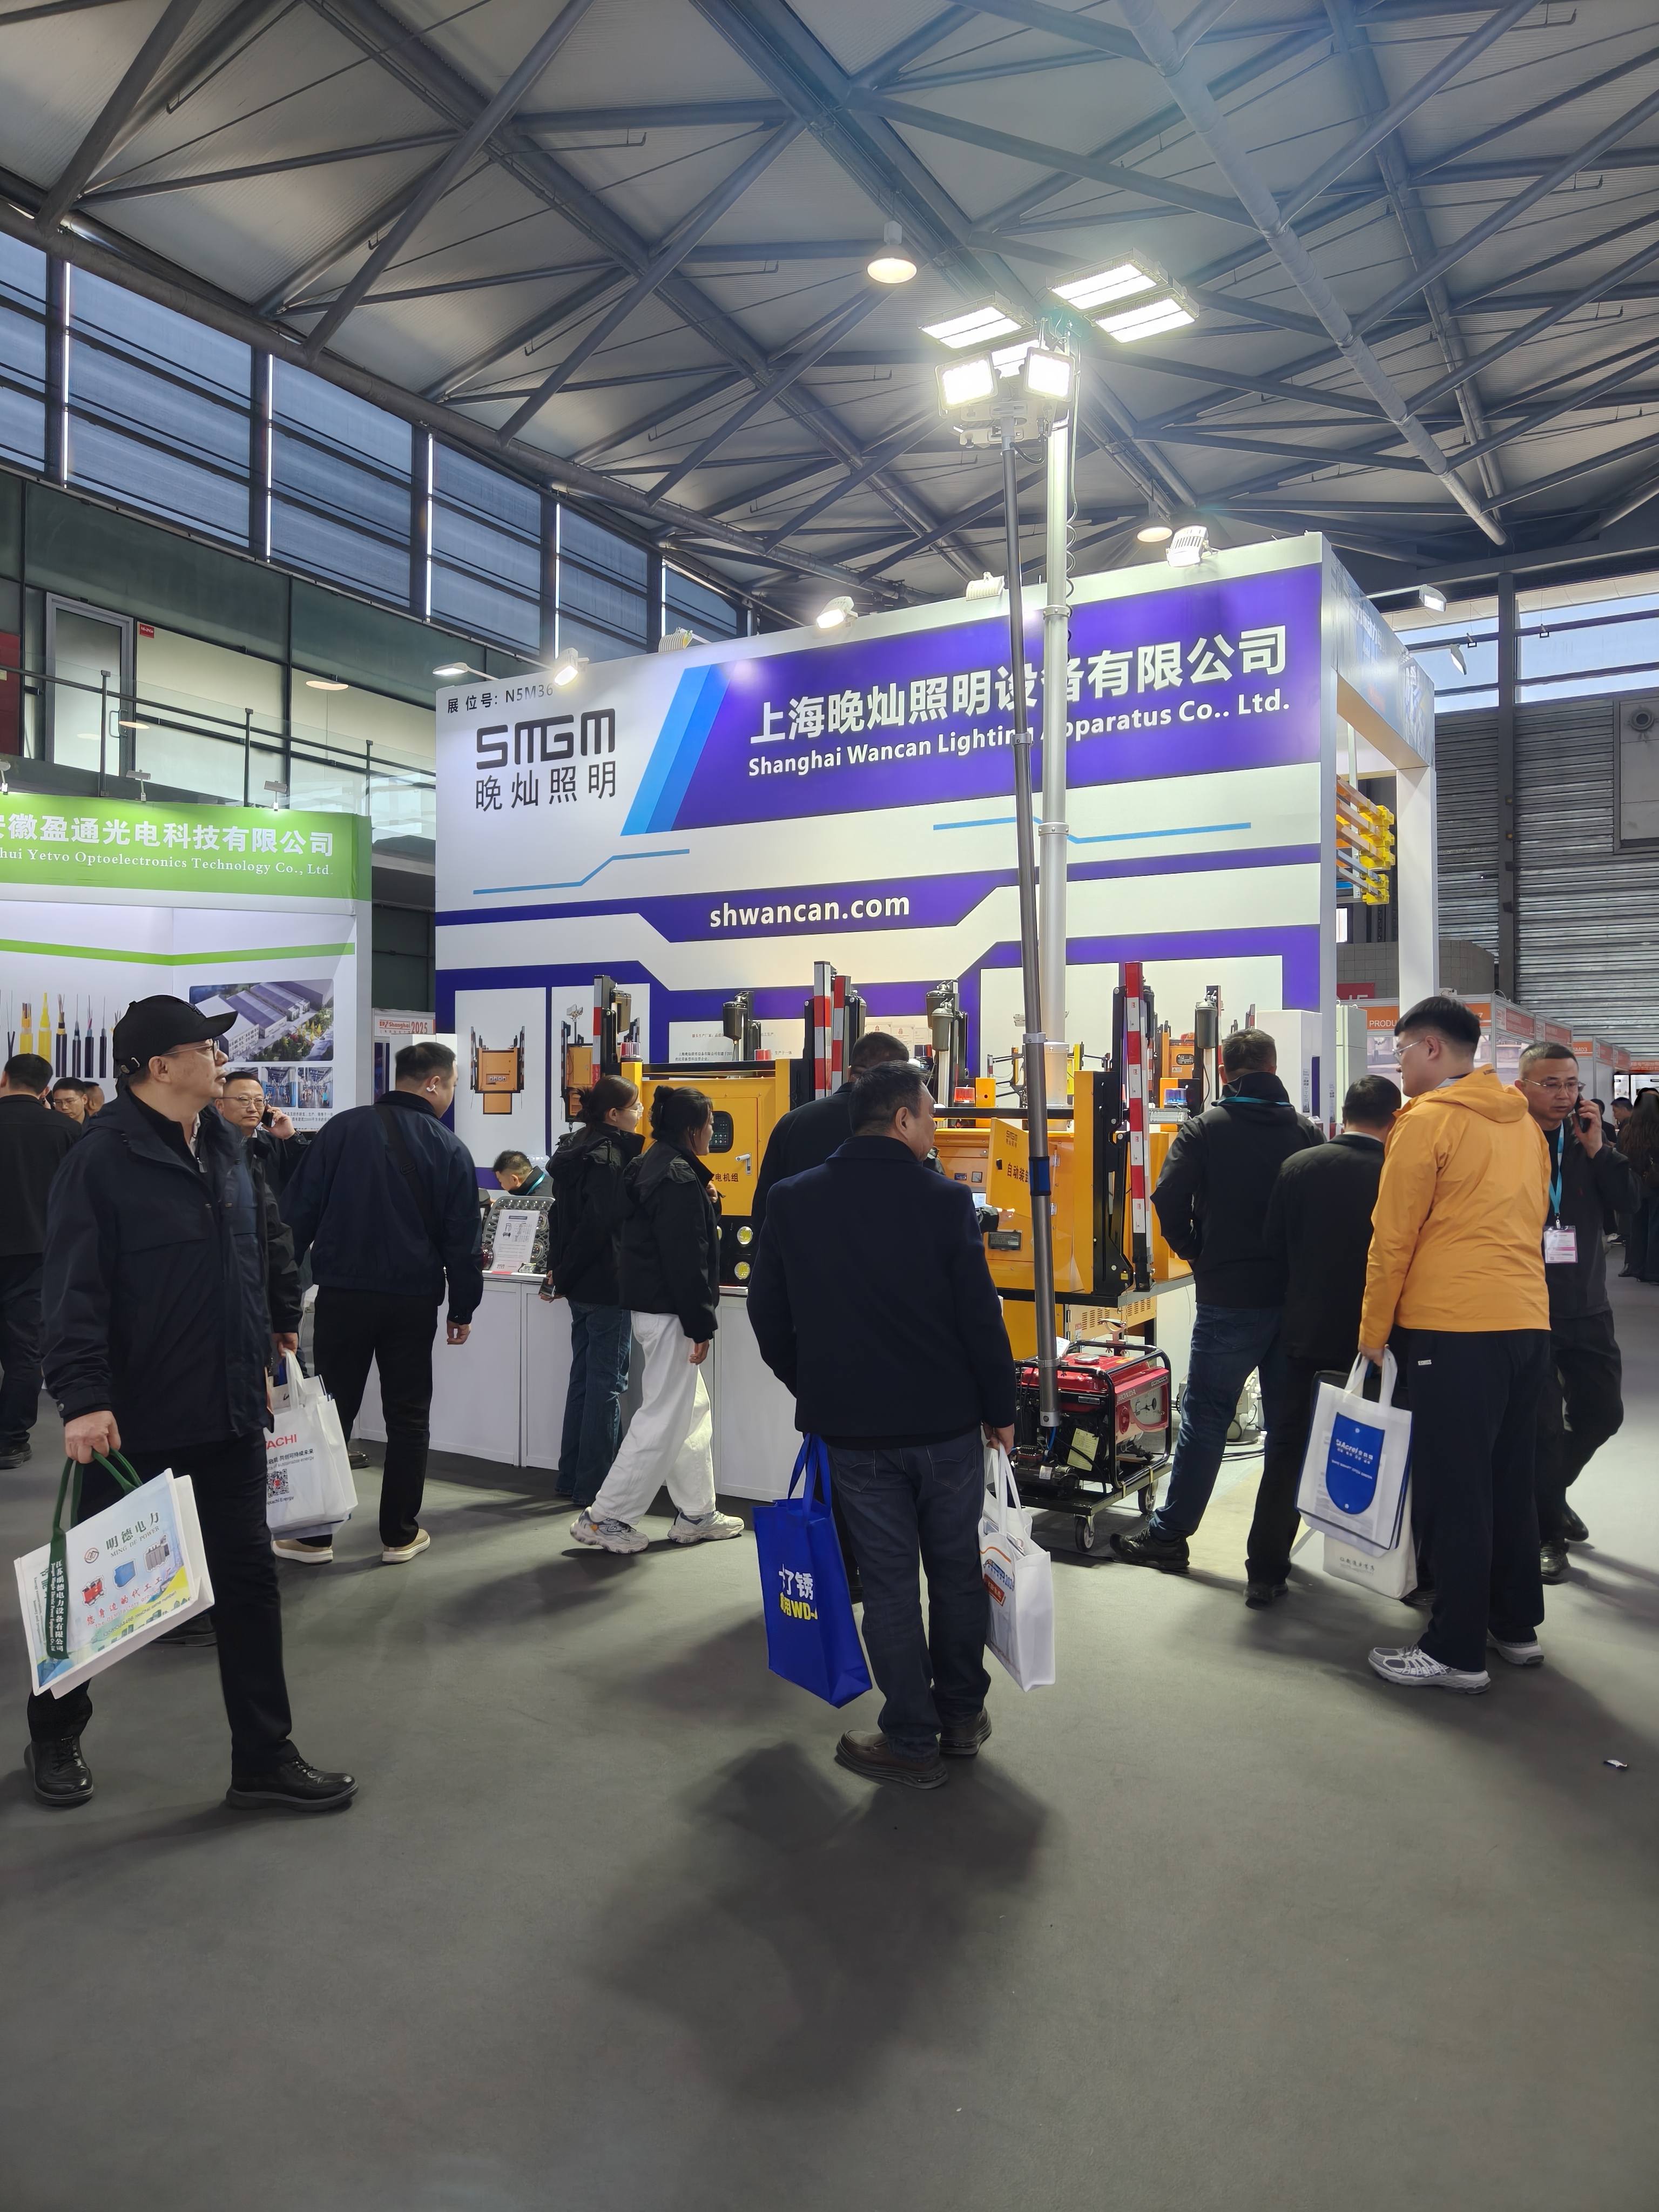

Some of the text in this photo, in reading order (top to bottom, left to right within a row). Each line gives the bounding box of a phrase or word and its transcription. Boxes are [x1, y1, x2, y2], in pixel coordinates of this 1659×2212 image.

[476, 708, 616, 770] SMGM
[748, 747, 841, 777] Shanghai
[847, 740, 932, 765] Wancan
[1238, 687, 1290, 715] Ltd.
[475, 760, 616, 812] 晚灿照明
[0, 813, 333, 857] 徽盈通光电科技有限公司
[27, 849, 70, 862] Yetvo
[75, 851, 187, 868] Optoelectronics
[191, 858, 271, 875] Technology
[275, 862, 304, 875] Co.,
[710, 895, 910, 928] shwancan.com
[411, 1021, 428, 1034] 2025
[711, 1172, 739, 1182] 电机组
[1117, 1389, 1137, 1402] HONDA
[266, 1434, 298, 1450] ACHI
[106, 1512, 159, 1550] 明德电力
[110, 1545, 127, 1558] MING
[139, 1526, 159, 1542] POWER
